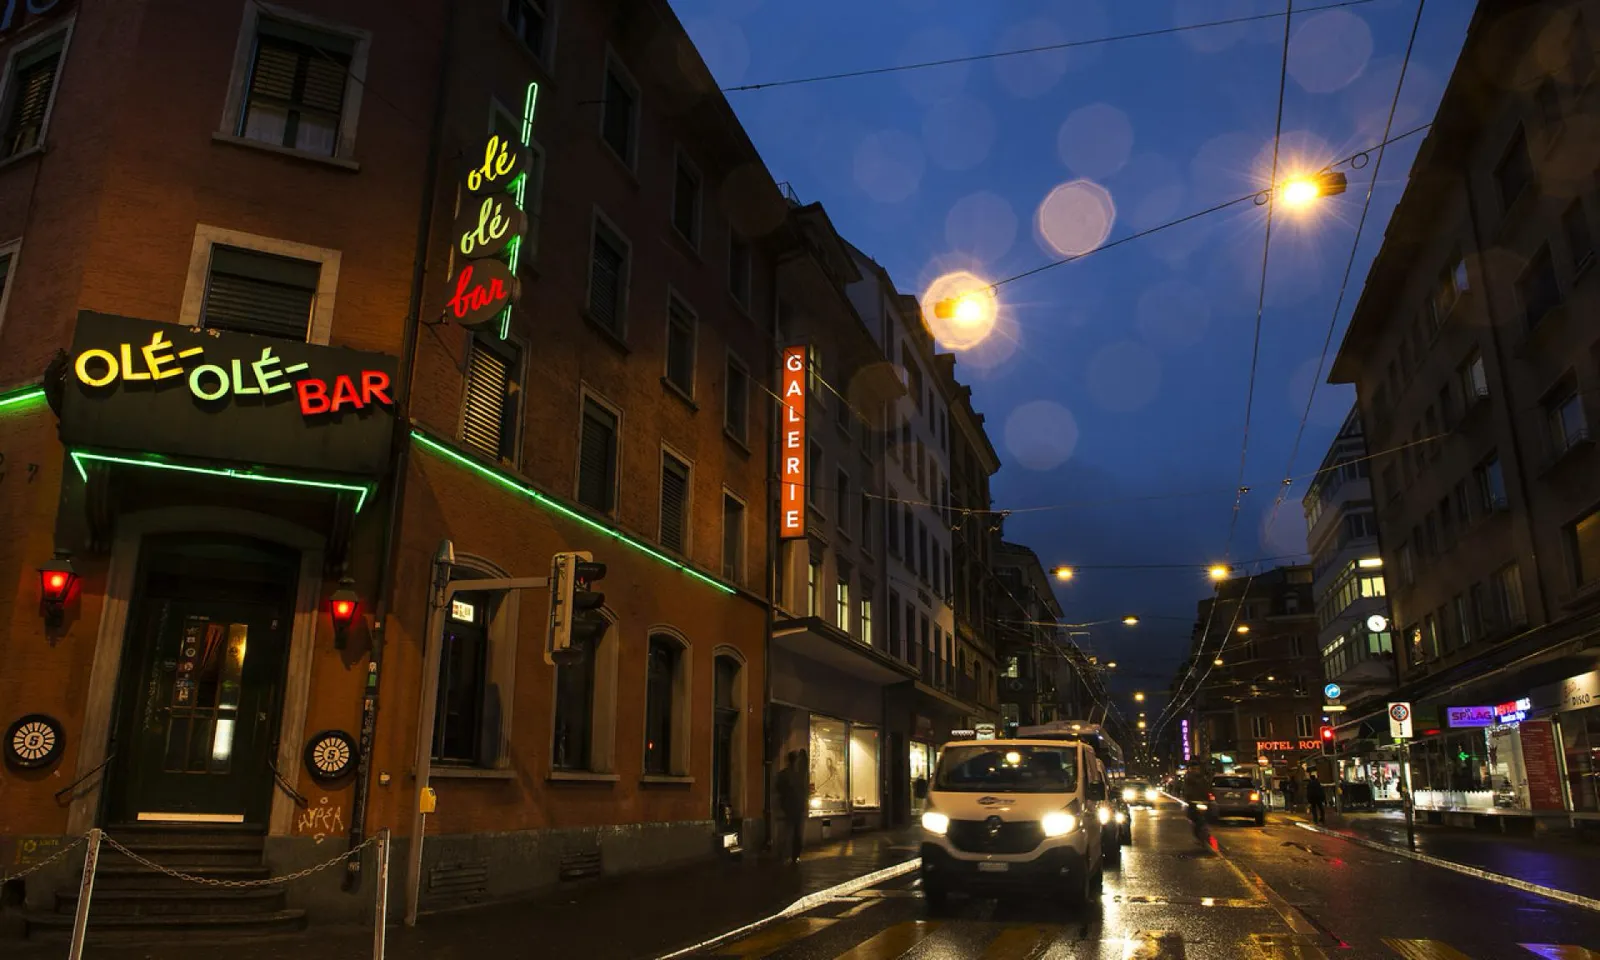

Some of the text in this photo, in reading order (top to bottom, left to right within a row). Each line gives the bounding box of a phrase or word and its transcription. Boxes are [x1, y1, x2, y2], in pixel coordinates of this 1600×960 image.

[468, 135, 516, 191] olé
[461, 197, 510, 254] olé
[448, 265, 507, 317] bar
[786, 354, 803, 528] GALERIE
[1256, 741, 1294, 750] HOTEL
